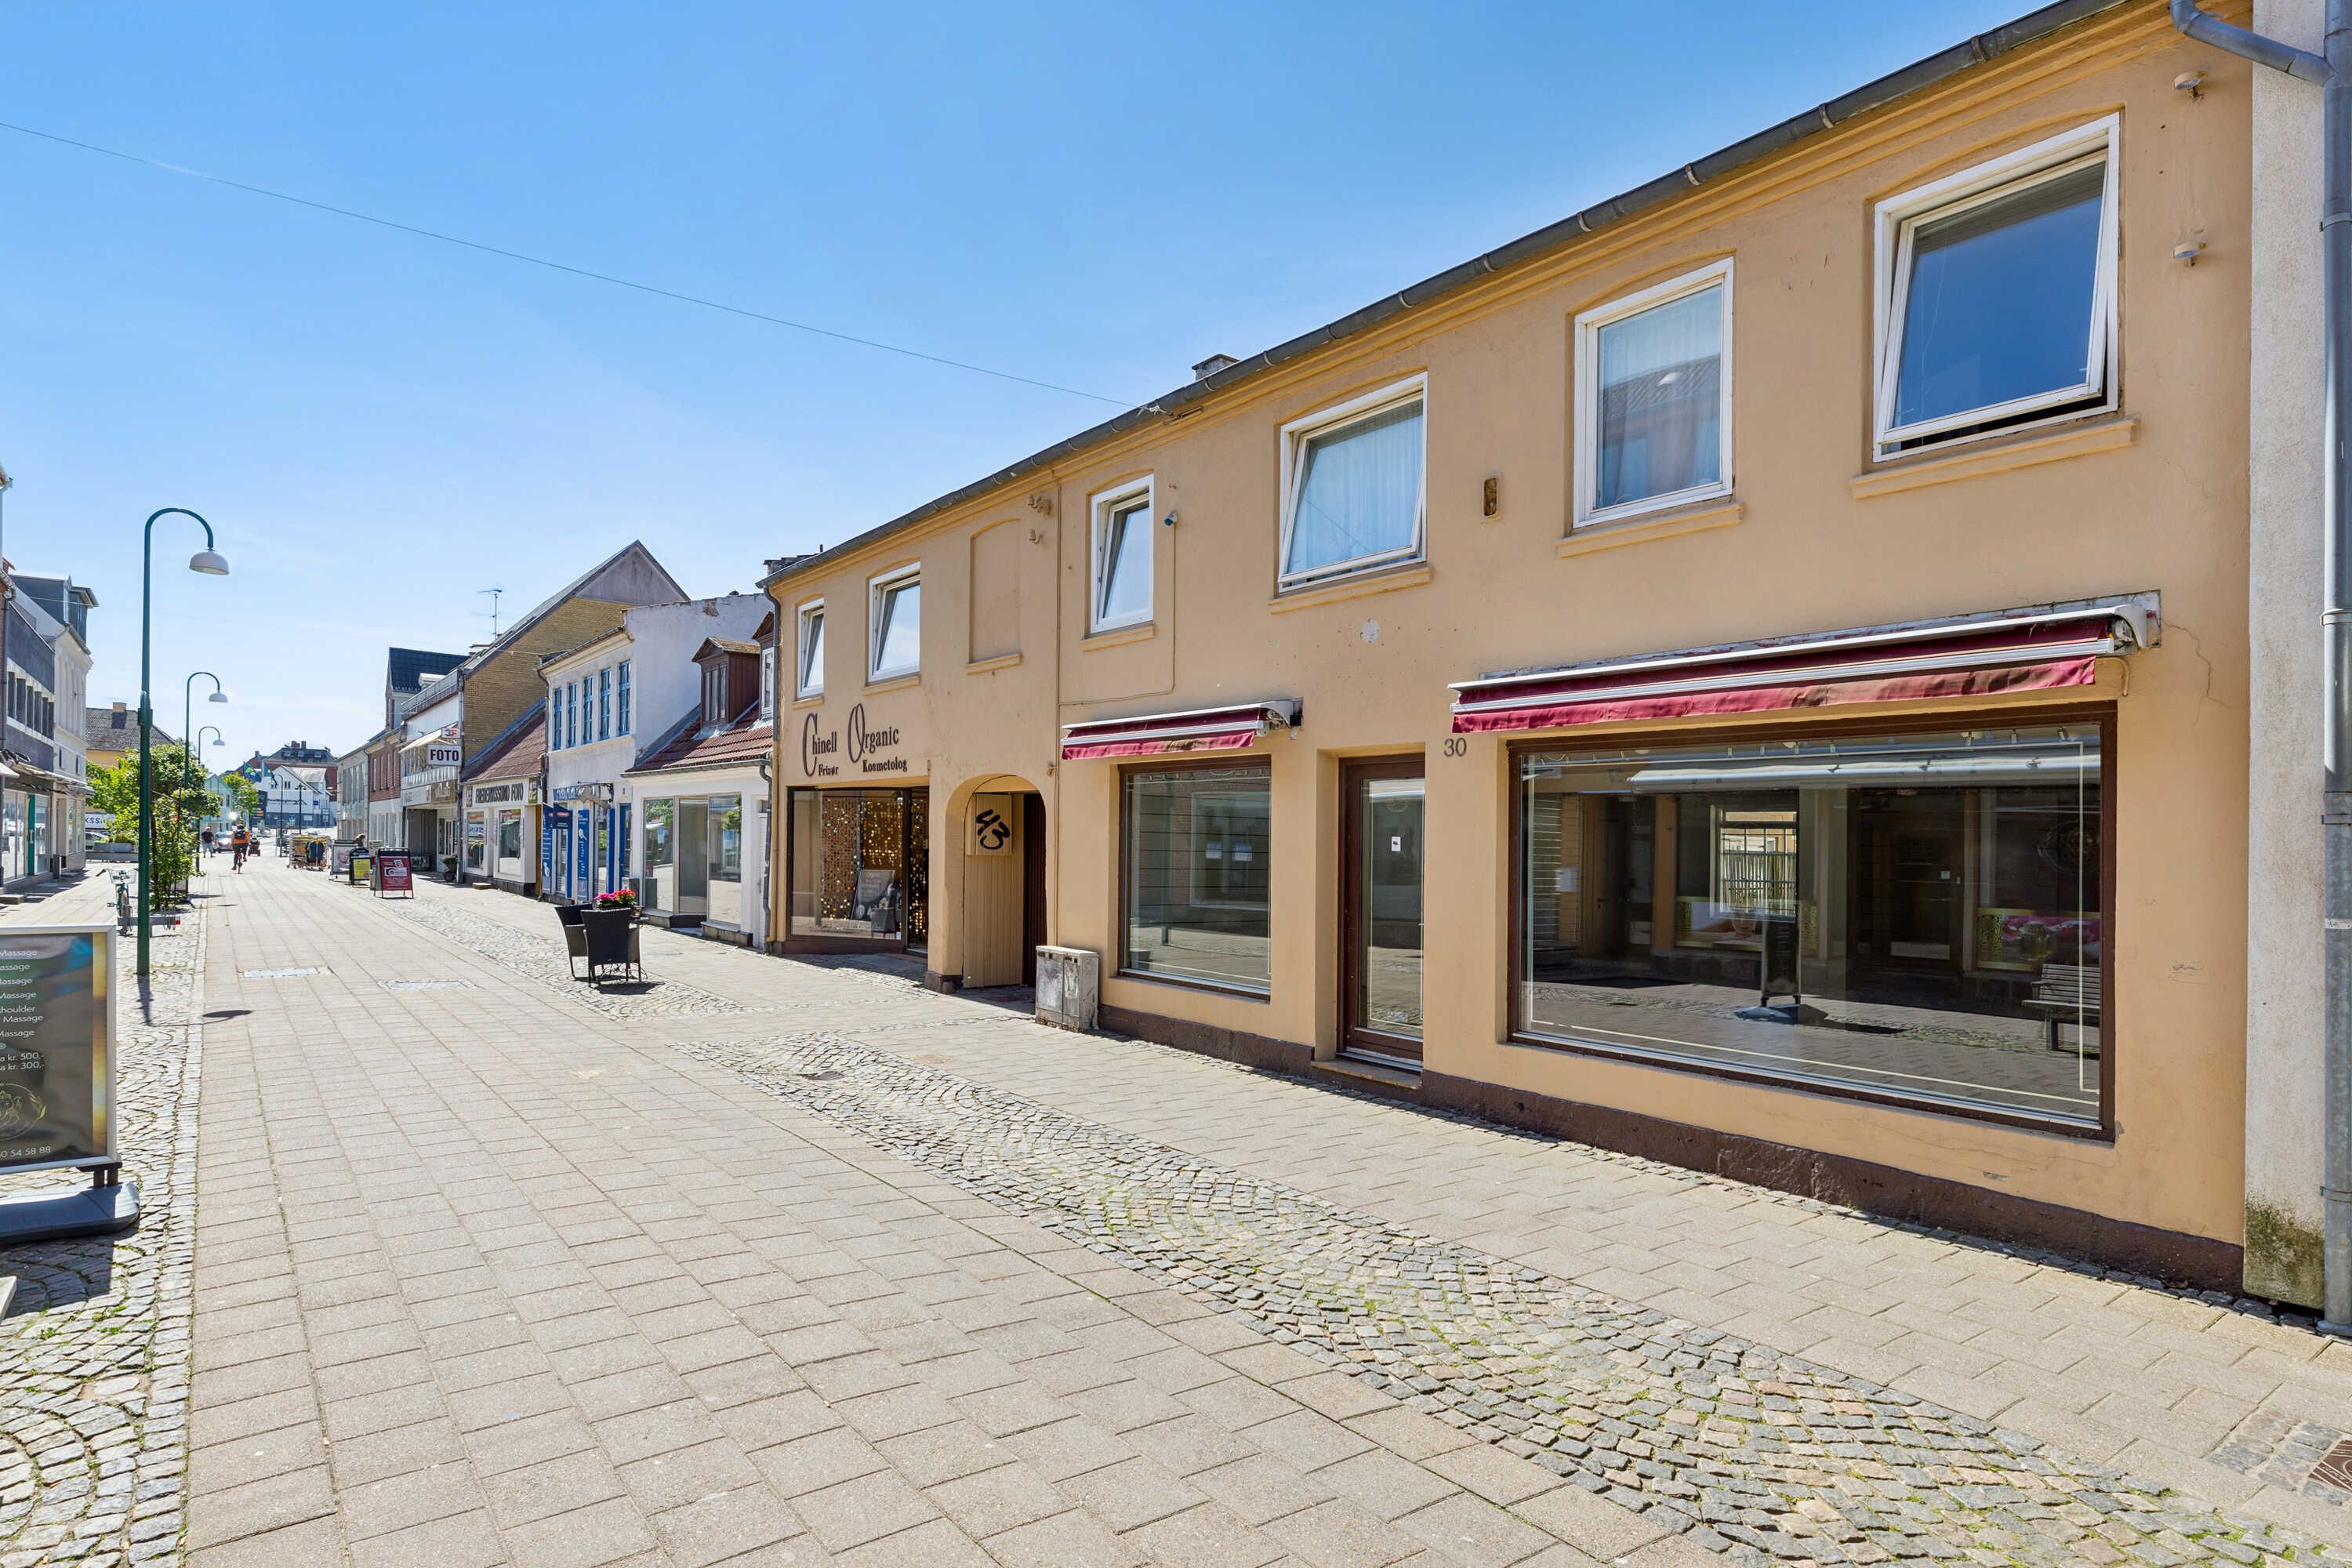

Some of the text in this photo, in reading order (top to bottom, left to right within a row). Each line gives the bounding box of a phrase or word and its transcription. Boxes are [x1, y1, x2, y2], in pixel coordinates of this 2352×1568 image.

[803, 703, 899, 777] Chinell Organic
[1443, 737, 1467, 757] 30
[430, 750, 459, 761] FOTO
[862, 757, 908, 772] Kosmetolog
[0, 1004, 36, 1014] houlder
[25, 1147, 37, 1156] 58
[39, 1145, 51, 1154] 88
